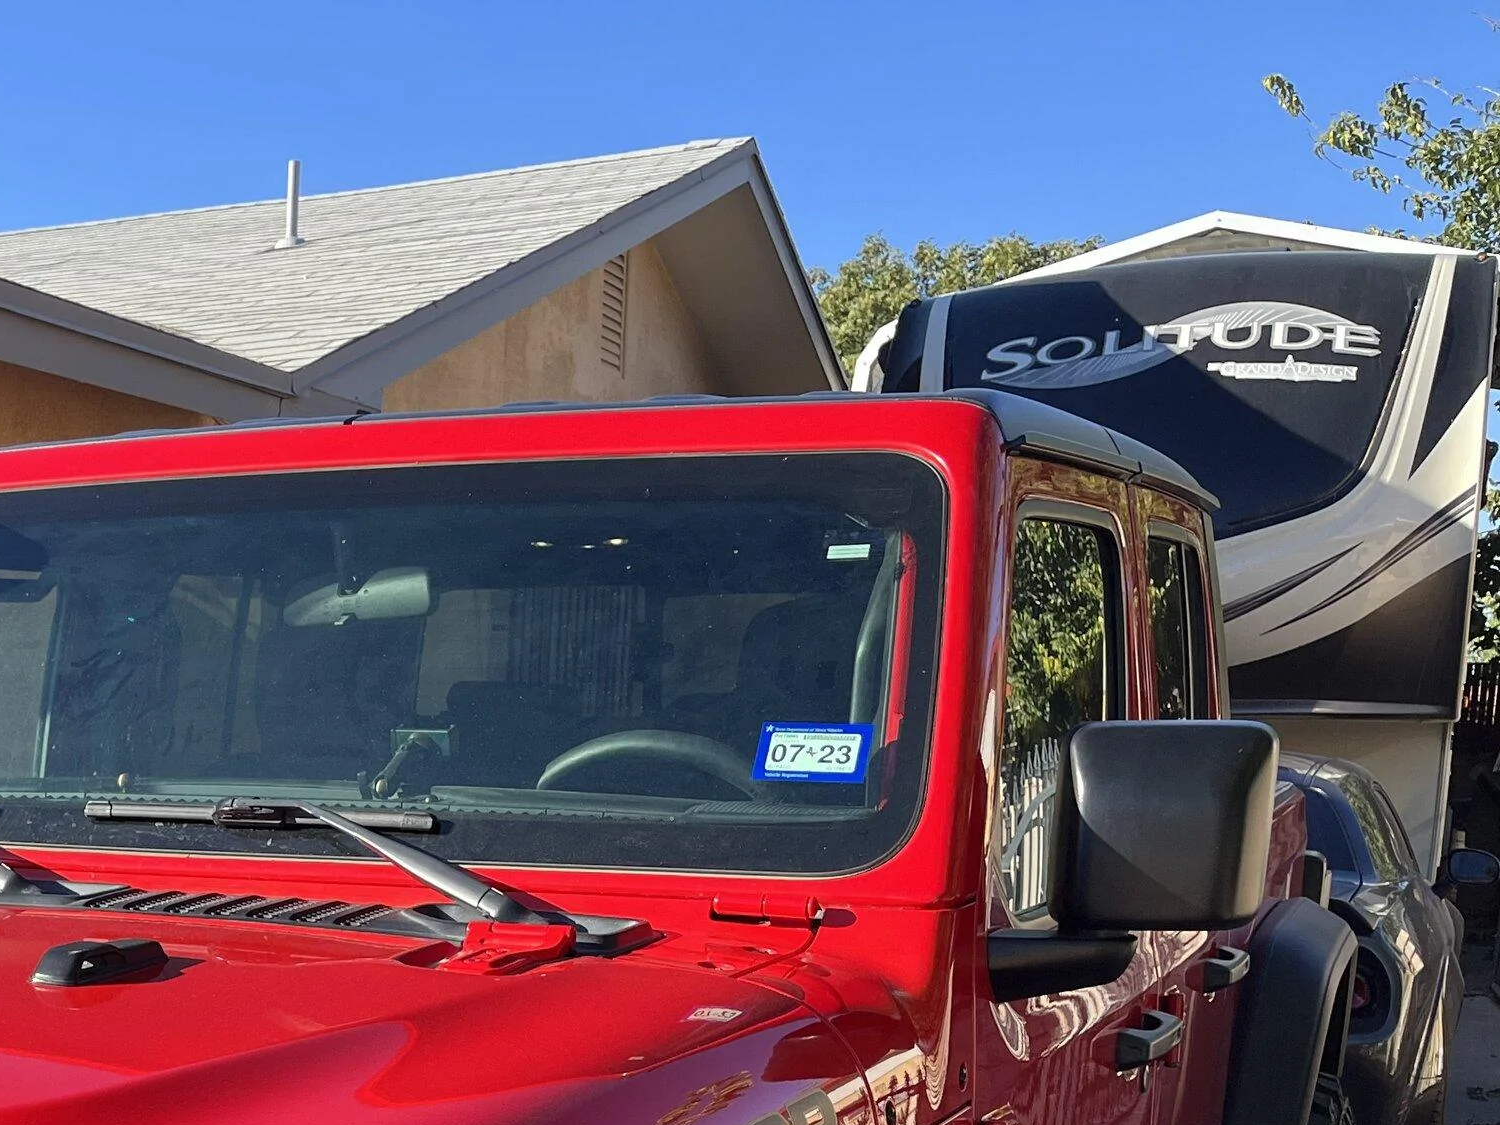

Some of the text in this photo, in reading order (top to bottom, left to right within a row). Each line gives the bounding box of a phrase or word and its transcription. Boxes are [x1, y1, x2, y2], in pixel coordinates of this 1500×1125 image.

[981, 321, 1382, 381] SOLITUDE
[770, 743, 853, 765] 07 23
